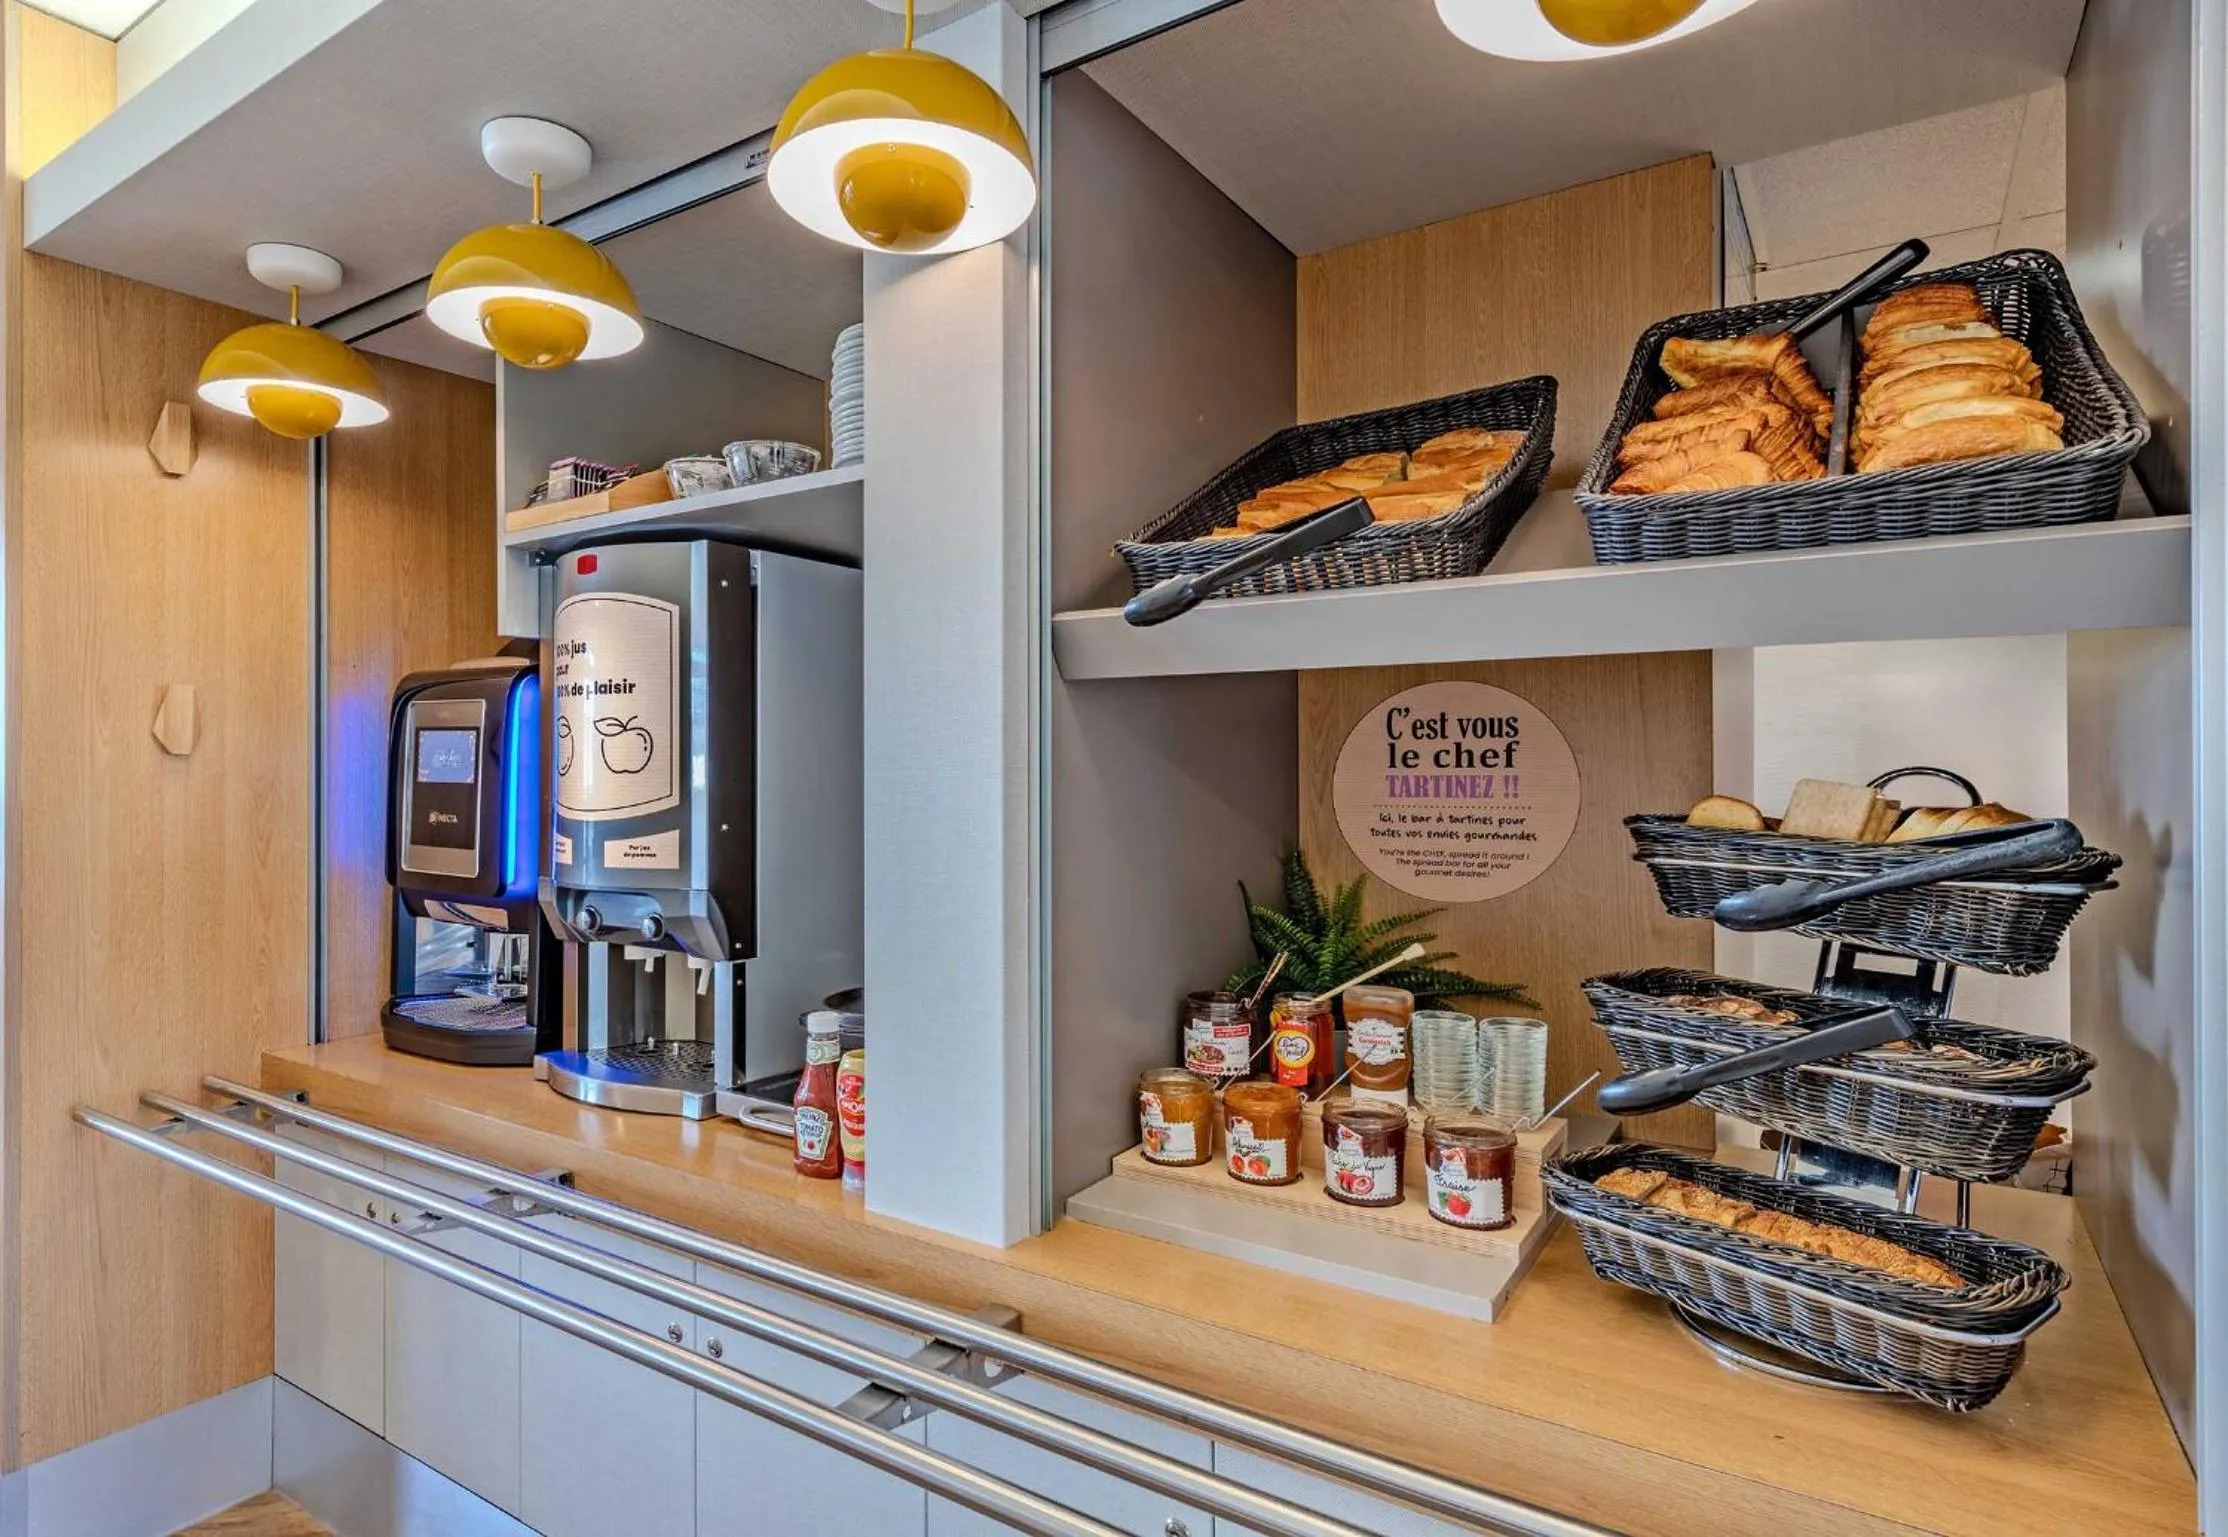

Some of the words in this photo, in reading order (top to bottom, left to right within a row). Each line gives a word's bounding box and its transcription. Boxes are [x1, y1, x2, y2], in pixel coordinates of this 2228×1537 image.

[571, 640, 586, 659] jus
[571, 682, 584, 696] de
[1457, 716, 1519, 739] vous
[1387, 742, 1420, 769] le
[1433, 741, 1520, 769] chef
[1385, 775, 1494, 798] TARTINEZ
[1503, 775, 1519, 798] !!
[1398, 813, 1407, 823] le
[1411, 815, 1431, 823] bar
[1436, 812, 1444, 823] à
[1448, 815, 1493, 825] tartines
[1499, 817, 1526, 828] pour
[1371, 828, 1401, 838] toutes
[1427, 831, 1460, 840] envies
[1464, 831, 1537, 843] gourmandes
[1491, 862, 1511, 871] your
